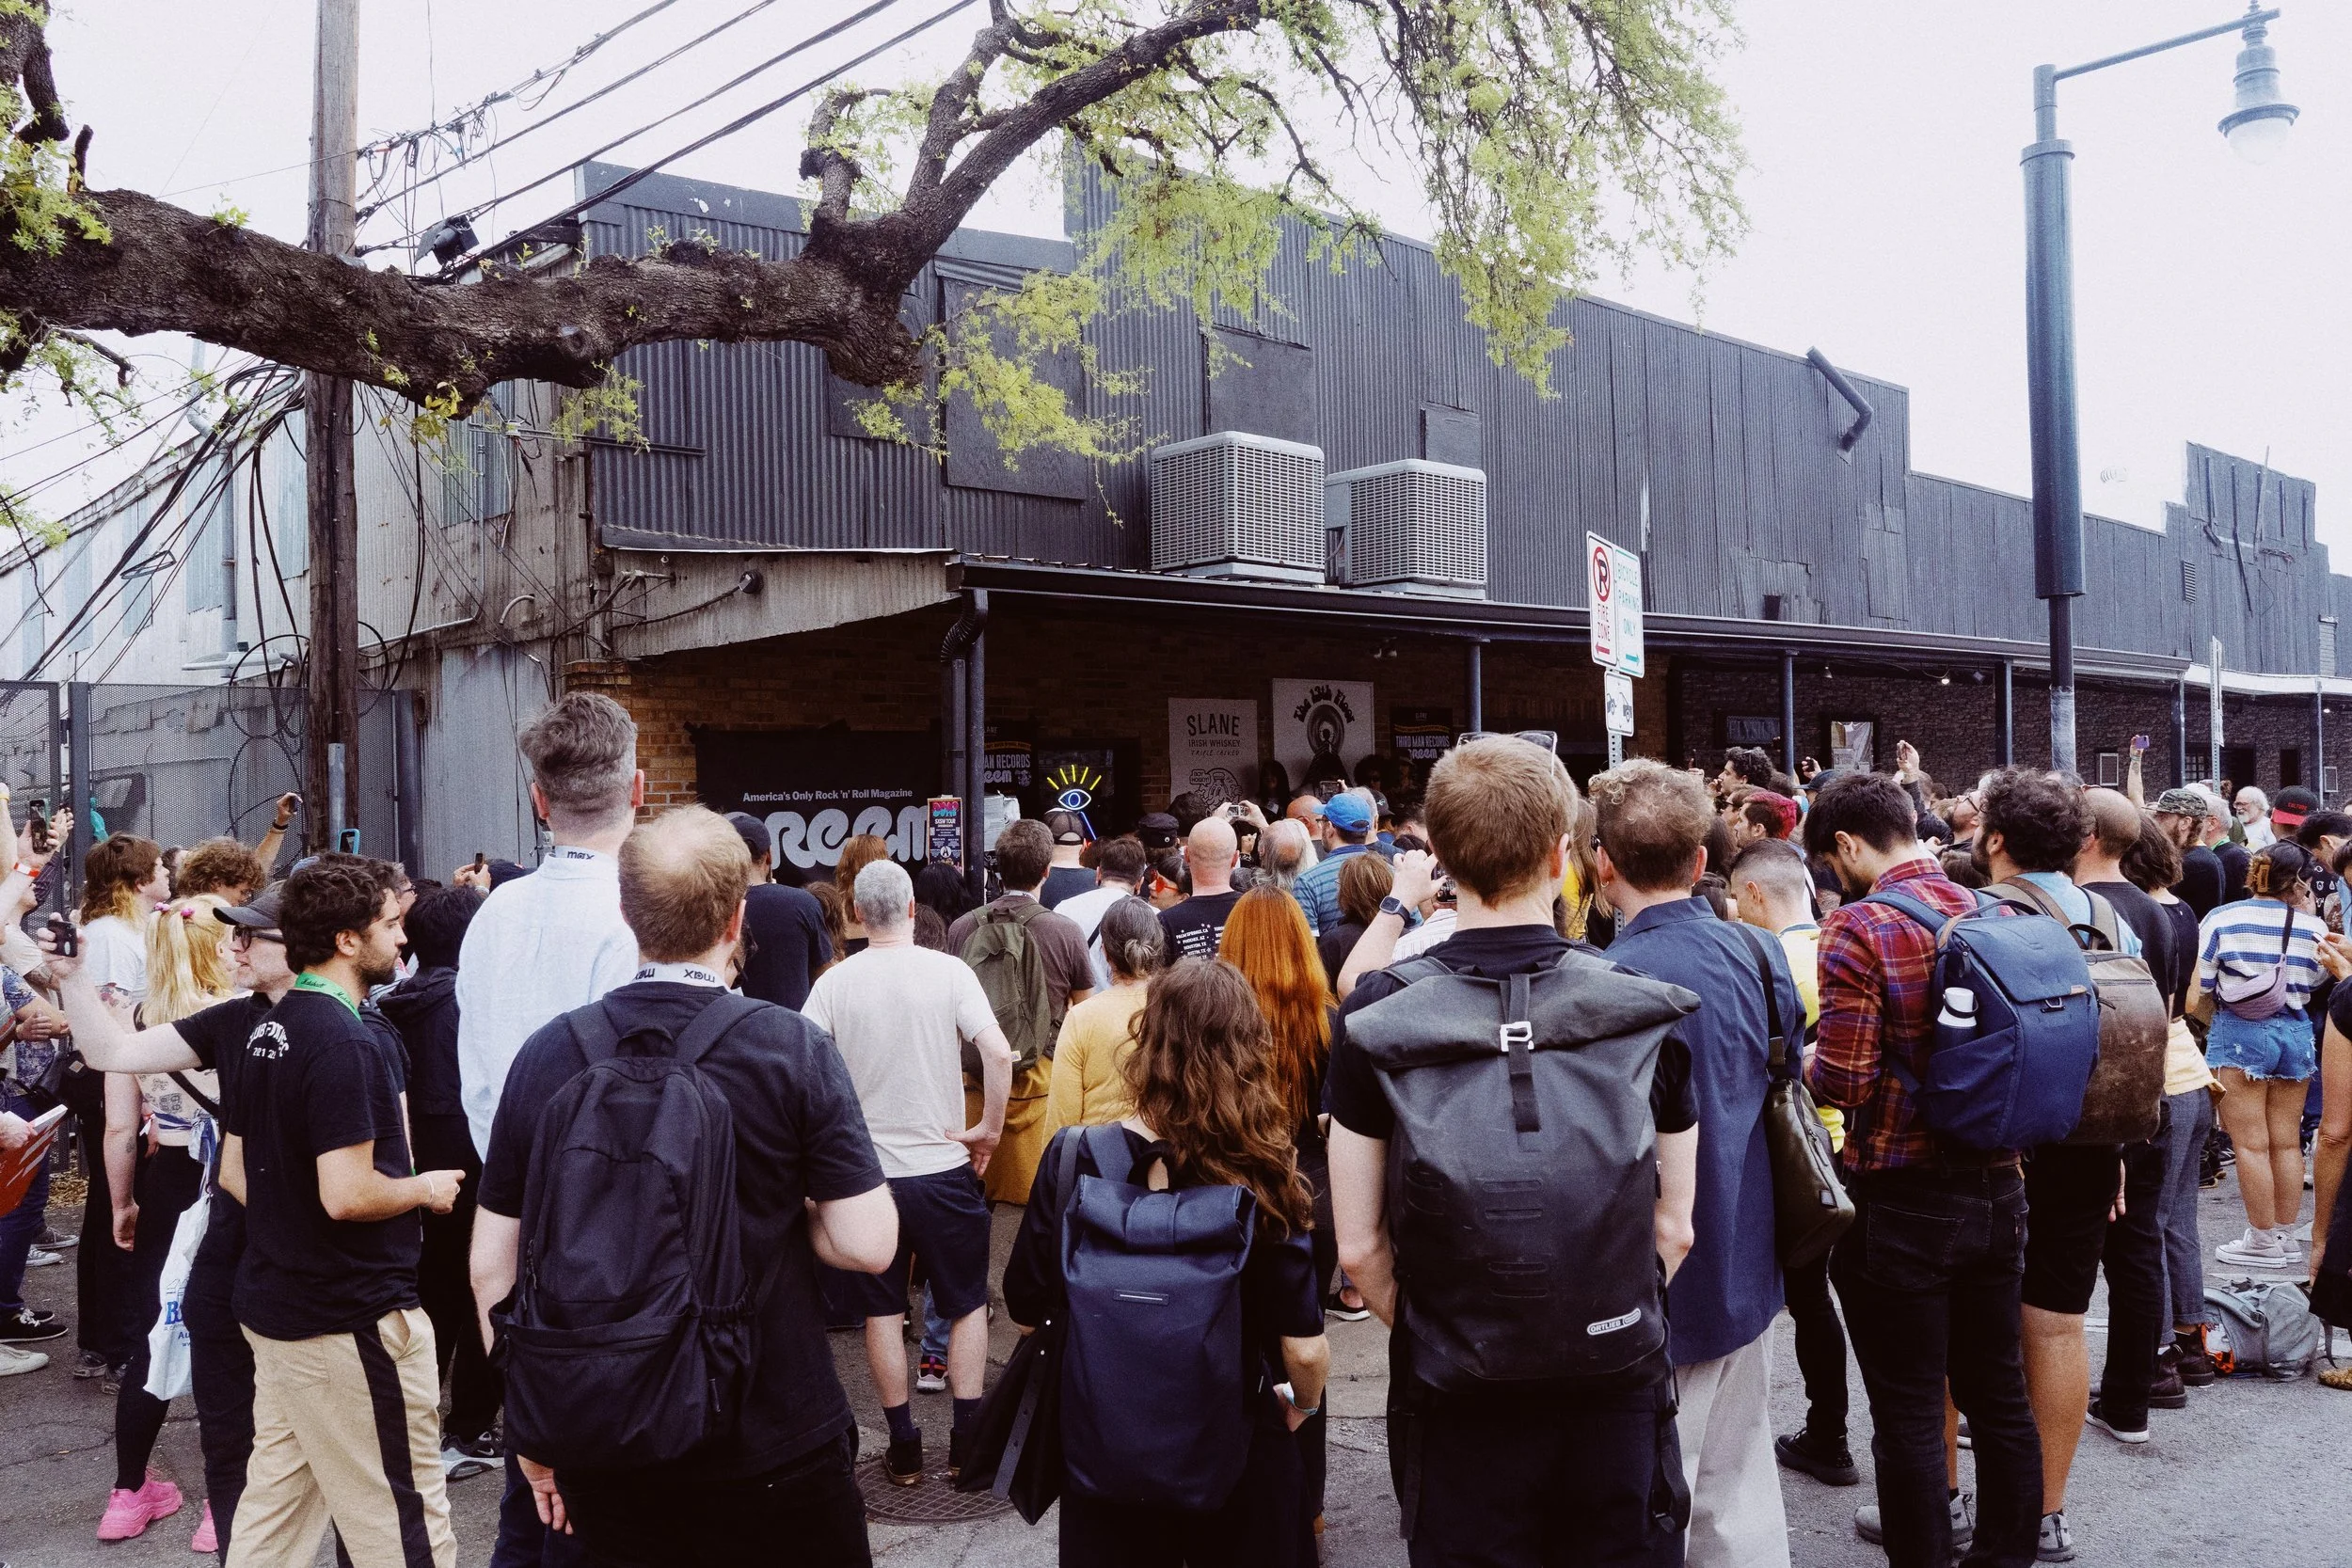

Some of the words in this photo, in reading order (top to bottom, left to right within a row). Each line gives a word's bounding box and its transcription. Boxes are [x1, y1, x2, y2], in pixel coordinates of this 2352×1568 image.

[1617, 562, 1638, 588] BICYCLE
[1618, 589, 1640, 613] PARKING
[1597, 603, 1609, 623] FIRE
[1597, 621, 1611, 641] ZONE
[1624, 618, 1636, 637] ONLY
[1294, 699, 1312, 723] The
[1334, 689, 1356, 724] Floor
[1186, 713, 1240, 736] SLANE
[1188, 739, 1208, 748] IRISH
[1209, 739, 1241, 748] WHISKEY
[1395, 736, 1411, 748] THIRD
[1412, 736, 1424, 748] MAN
[1425, 736, 1451, 748] RECORDS
[984, 754, 995, 768] AN
[995, 753, 1031, 768] RECORDS
[742, 791, 791, 802] America's
[792, 790, 814, 801] Only
[815, 790, 838, 800] Rock
[851, 789, 869, 799] Roll
[870, 788, 913, 800] Magazine
[683, 969, 716, 983] max
[1590, 1320, 1621, 1333] ORTLIEB
